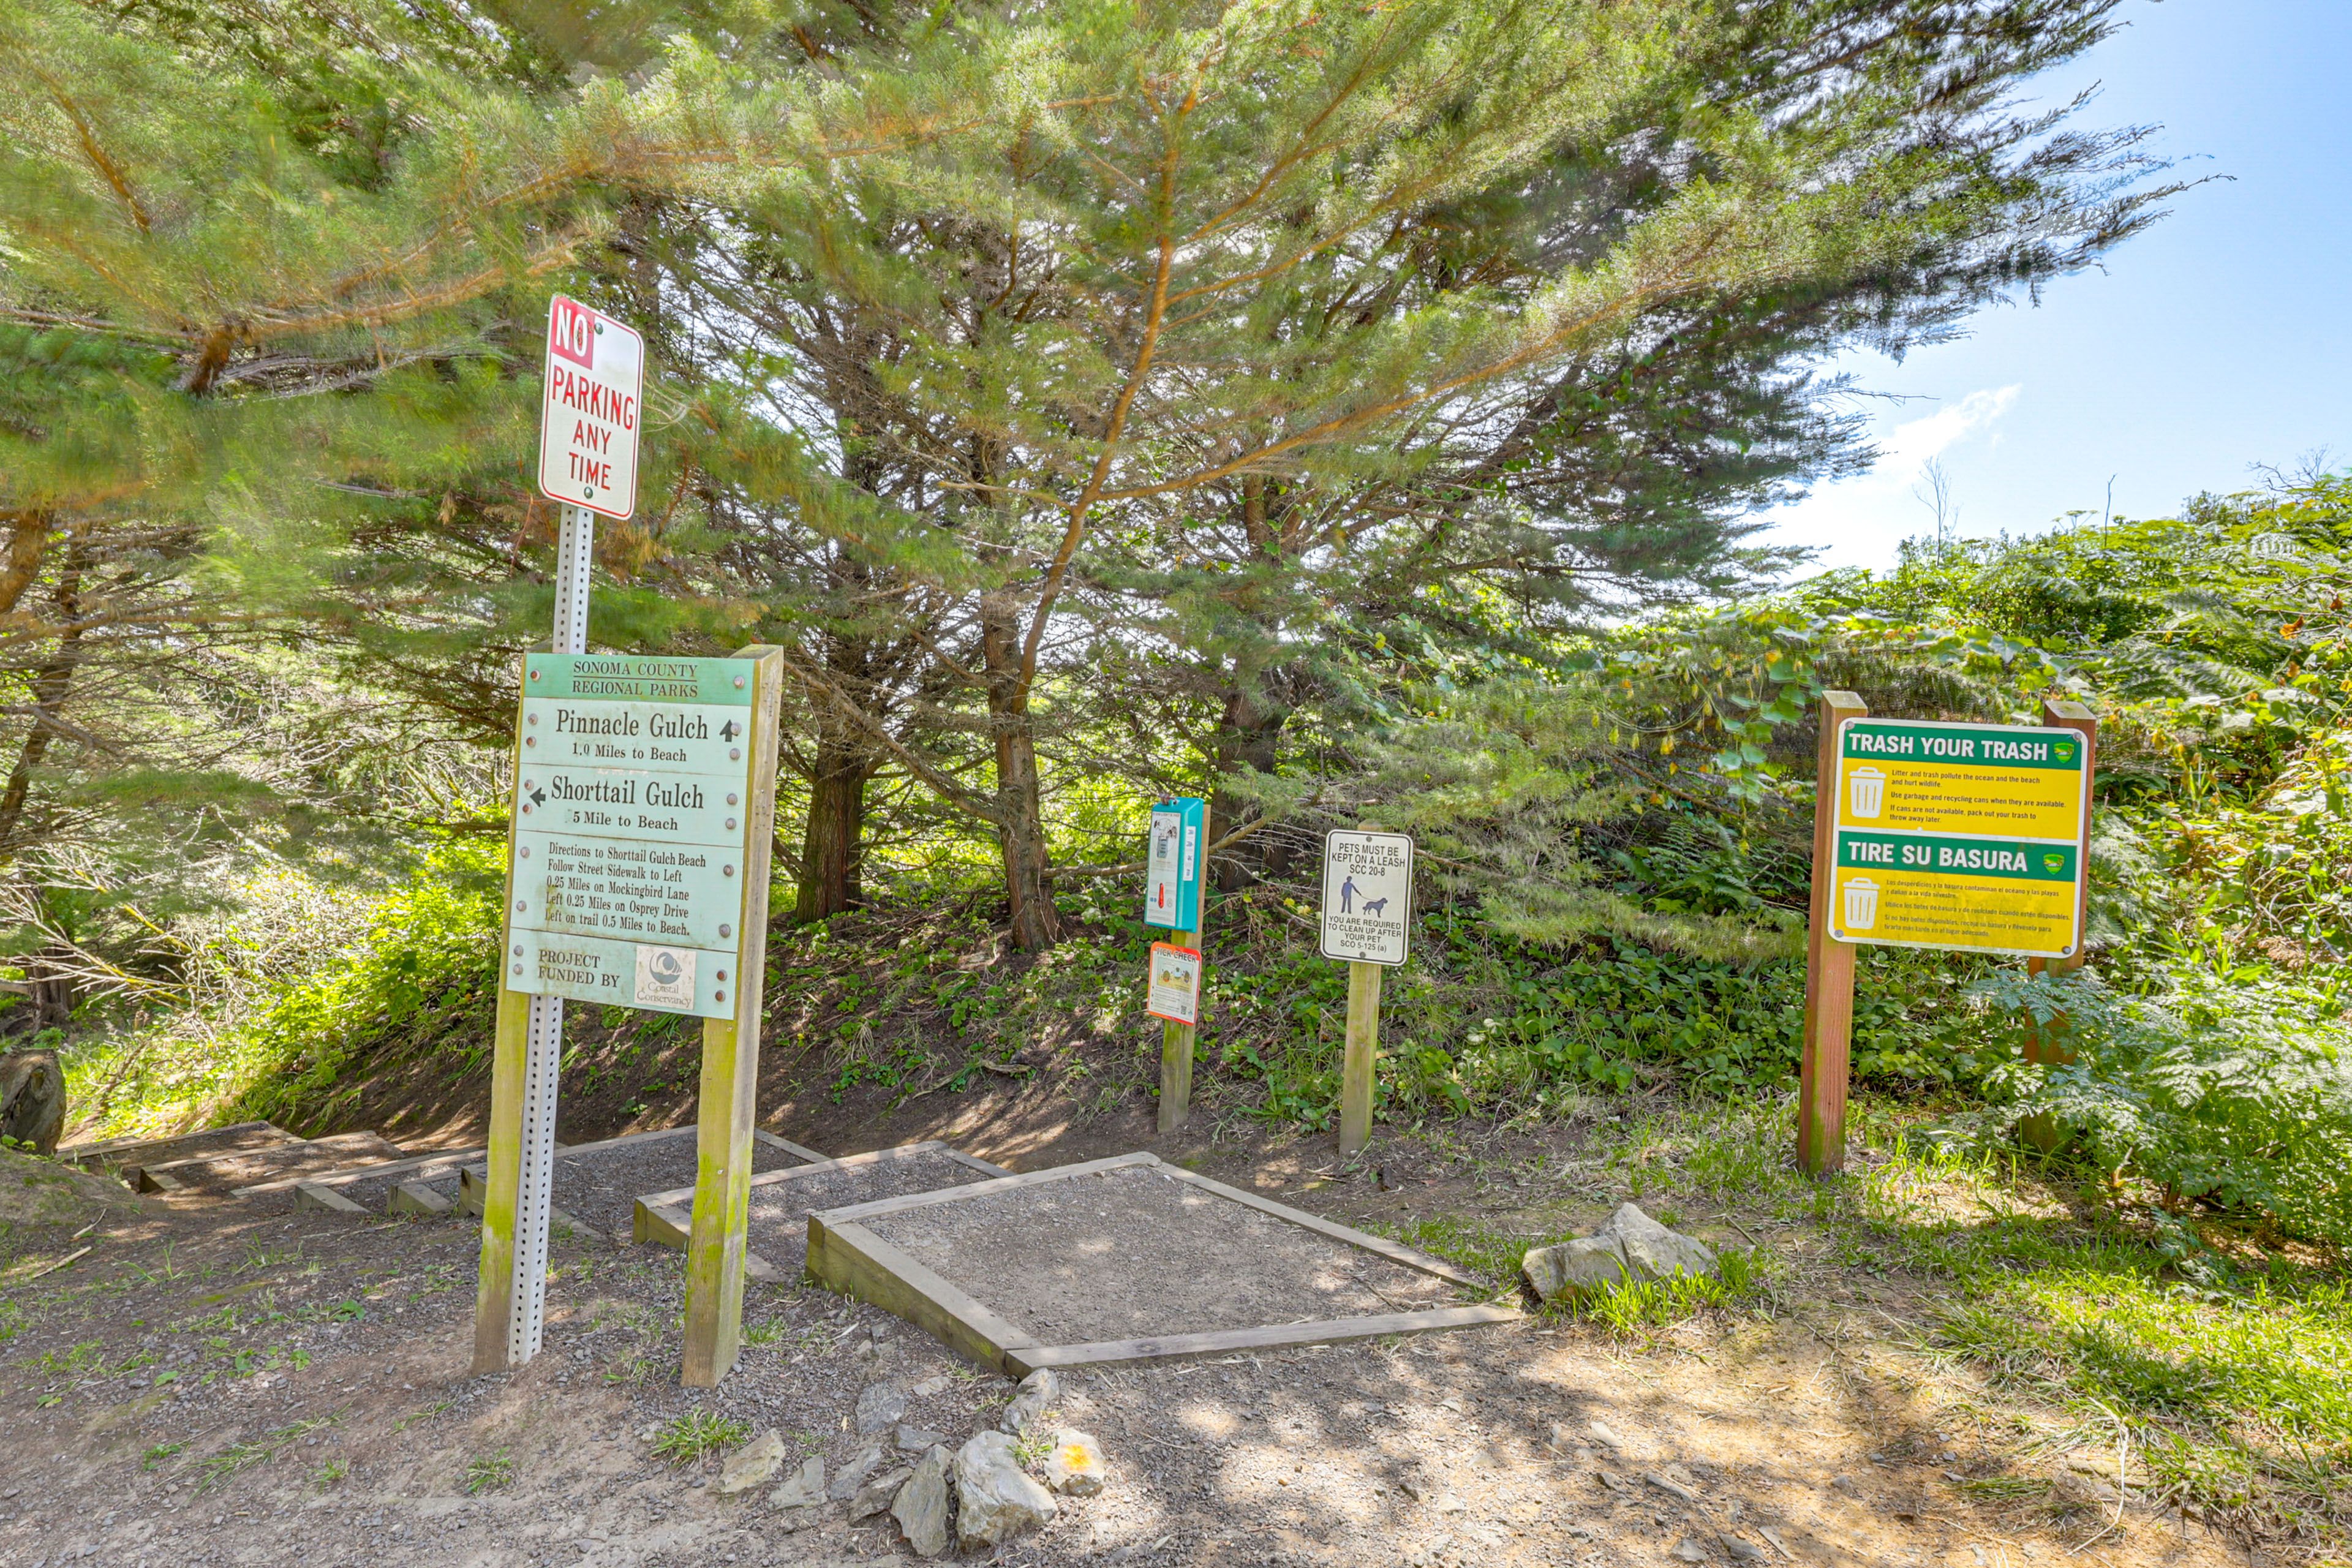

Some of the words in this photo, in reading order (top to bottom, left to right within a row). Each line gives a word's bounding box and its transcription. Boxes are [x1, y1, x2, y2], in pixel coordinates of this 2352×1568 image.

[556, 304, 588, 357] NO
[552, 365, 634, 430] PARKING
[573, 420, 611, 455] ANY
[568, 451, 611, 490] TIME
[573, 661, 630, 674] SONOMA
[638, 663, 698, 677] COUNTY
[572, 680, 643, 695] REGIONAL
[650, 684, 698, 698] PARKS
[556, 709, 639, 736] Pinnacle
[650, 713, 708, 739] Gulch
[573, 742, 590, 756] 1.0
[595, 744, 626, 758] Miles
[632, 747, 644, 759] to
[650, 747, 687, 762] Beach
[1849, 733, 1913, 754] TRASH
[1921, 737, 1975, 758] YOUR
[1981, 740, 2047, 761] TRASH
[551, 775, 635, 804] Shorttail
[646, 781, 704, 809] Gulch
[584, 811, 611, 826] Mile
[618, 815, 631, 827] to
[638, 815, 678, 831] Beach
[549, 842, 591, 858] Directions
[595, 848, 603, 858] to
[608, 846, 646, 862] Shorttail
[649, 850, 675, 865] Gulch
[678, 853, 706, 867] Beach
[1332, 852, 1352, 862] KEPT
[1355, 854, 1366, 864] ON
[1369, 856, 1374, 865] A
[1377, 856, 1405, 867] LEASH
[1339, 843, 1360, 853] PETS
[1362, 845, 1385, 855] MUST
[1387, 846, 1398, 856] BE
[1847, 842, 1894, 862] TIRE
[1901, 845, 1931, 865] SU
[1939, 846, 2027, 872] BASURA
[548, 858, 575, 872] Follow
[578, 861, 603, 875] Street
[608, 864, 646, 879] Sidewalk
[650, 869, 659, 880] to
[663, 869, 682, 882] Left
[1349, 864, 1366, 875] SCC
[1368, 866, 1385, 876] 20-8
[547, 875, 564, 888] 0.25
[568, 877, 590, 891] Miles
[594, 883, 604, 892] on
[608, 881, 663, 899] Mockingbird
[668, 886, 689, 900] Lane
[546, 892, 562, 905] Left
[567, 894, 584, 907] 0.25
[589, 896, 611, 910] Miles
[615, 903, 625, 911] on
[630, 900, 659, 918] Osprey
[664, 903, 688, 918] Drive
[545, 908, 562, 922] Left
[566, 914, 575, 923] on
[580, 913, 598, 925] trail
[603, 914, 616, 927] 0.5
[620, 916, 643, 931] Miles
[647, 921, 655, 932] to
[660, 921, 690, 935] Beach.
[1339, 924, 1363, 933] CLEAN
[1377, 929, 1401, 937] AFTER
[1363, 919, 1401, 930] REQUIRED
[1340, 940, 1355, 948] SCO
[1357, 942, 1376, 951] 5-125
[1345, 932, 1365, 941] YOUR
[539, 949, 600, 968] PROJECT
[1156, 948, 1171, 957] TICK
[1174, 951, 1196, 963] CHECK
[538, 966, 594, 984] FUNDED
[601, 974, 620, 987] BY
[648, 981, 679, 993] Coastal
[637, 990, 692, 1008] Conservancy
